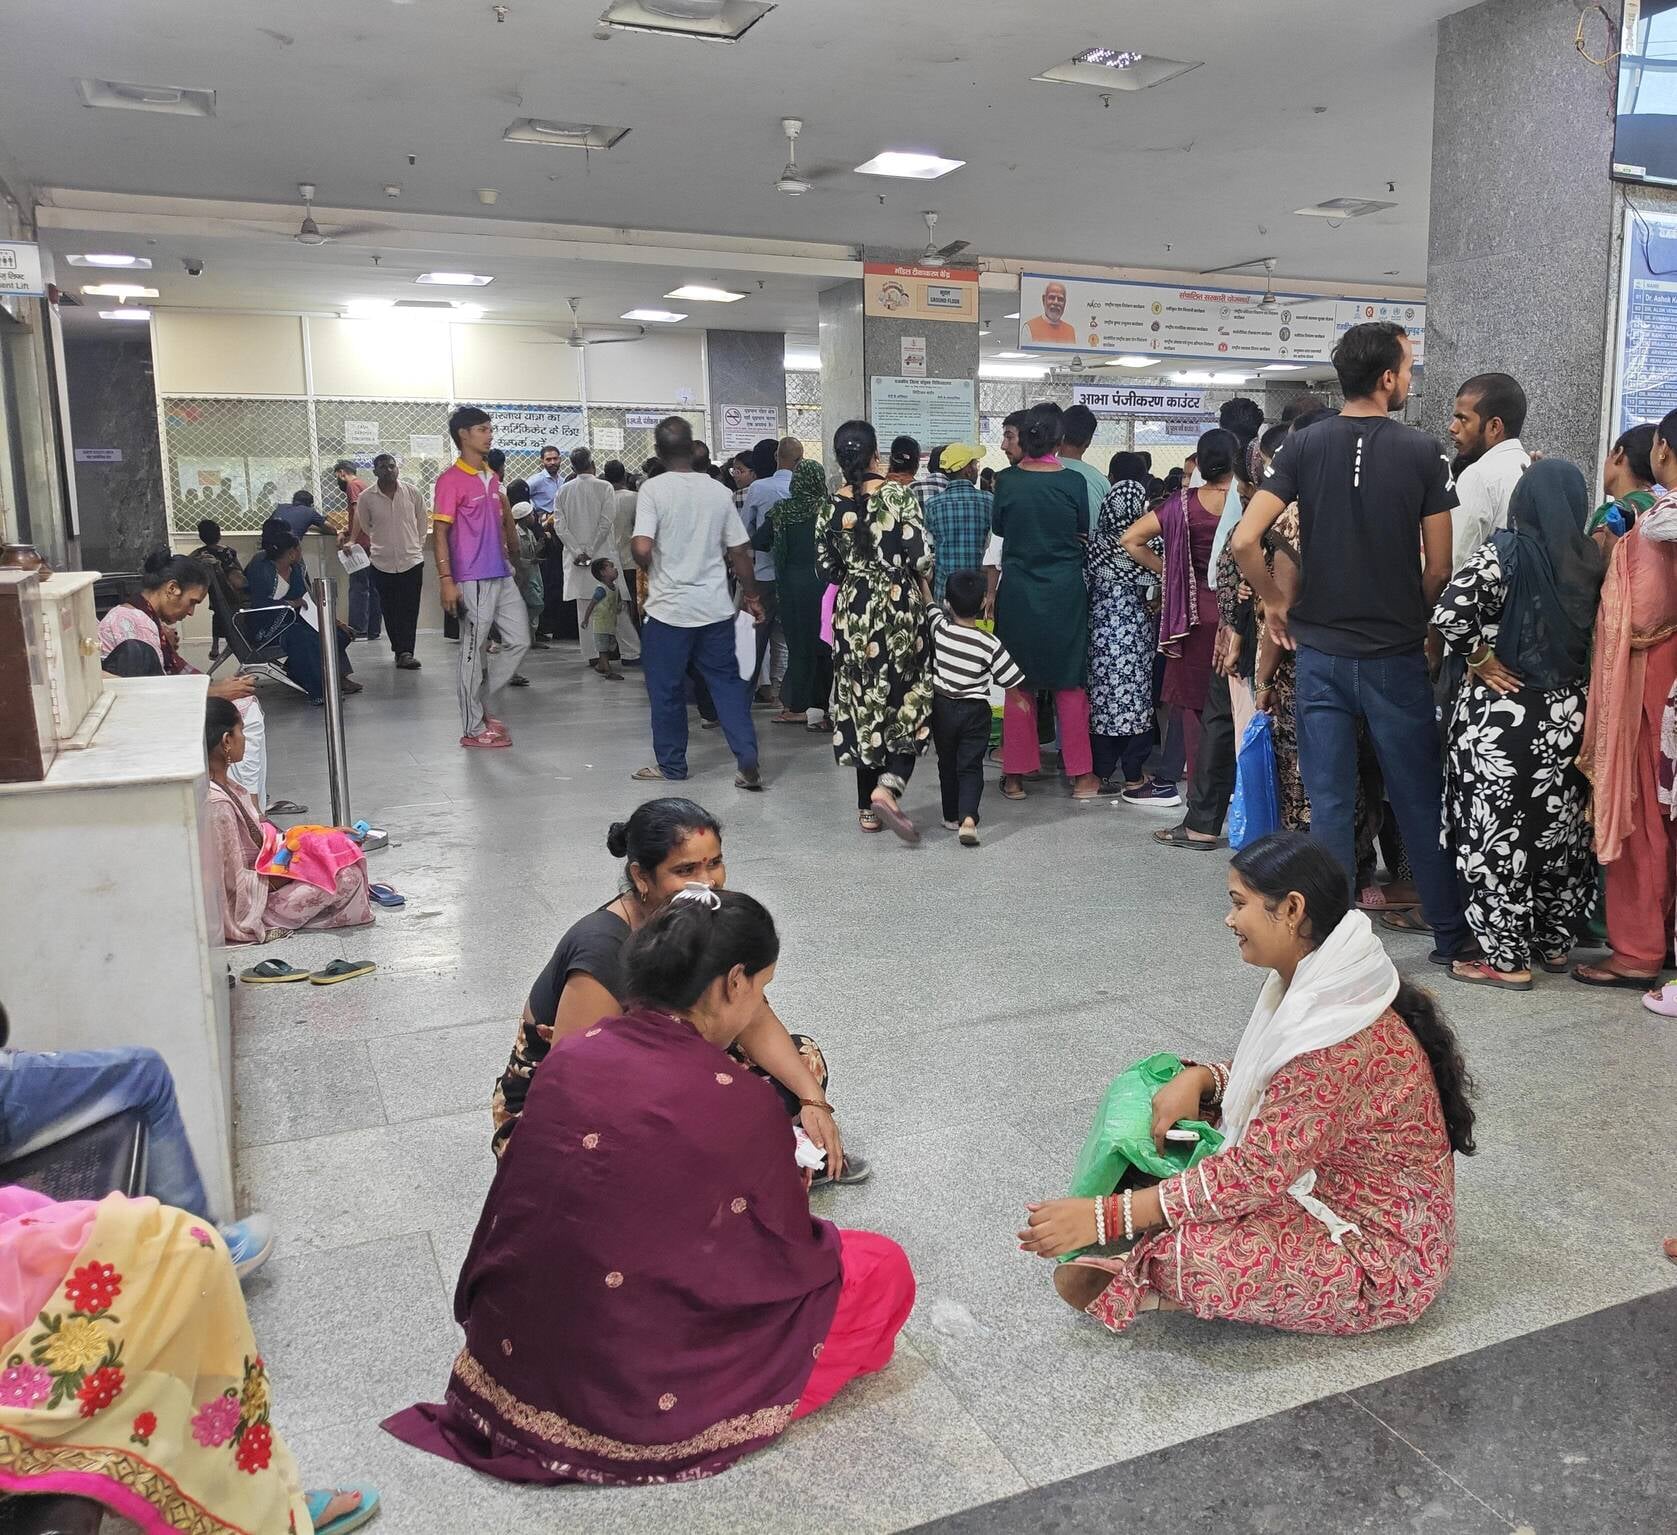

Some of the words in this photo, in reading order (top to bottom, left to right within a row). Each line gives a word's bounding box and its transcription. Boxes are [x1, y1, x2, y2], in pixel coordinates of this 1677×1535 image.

[1079, 393, 1109, 406] आभा
[1112, 390, 1164, 408] पंजीकरण
[1166, 393, 1200, 409] काउंटर
[524, 412, 545, 421] यात्रा
[547, 412, 561, 422] का
[549, 425, 559, 435] के
[562, 424, 580, 436] लिए
